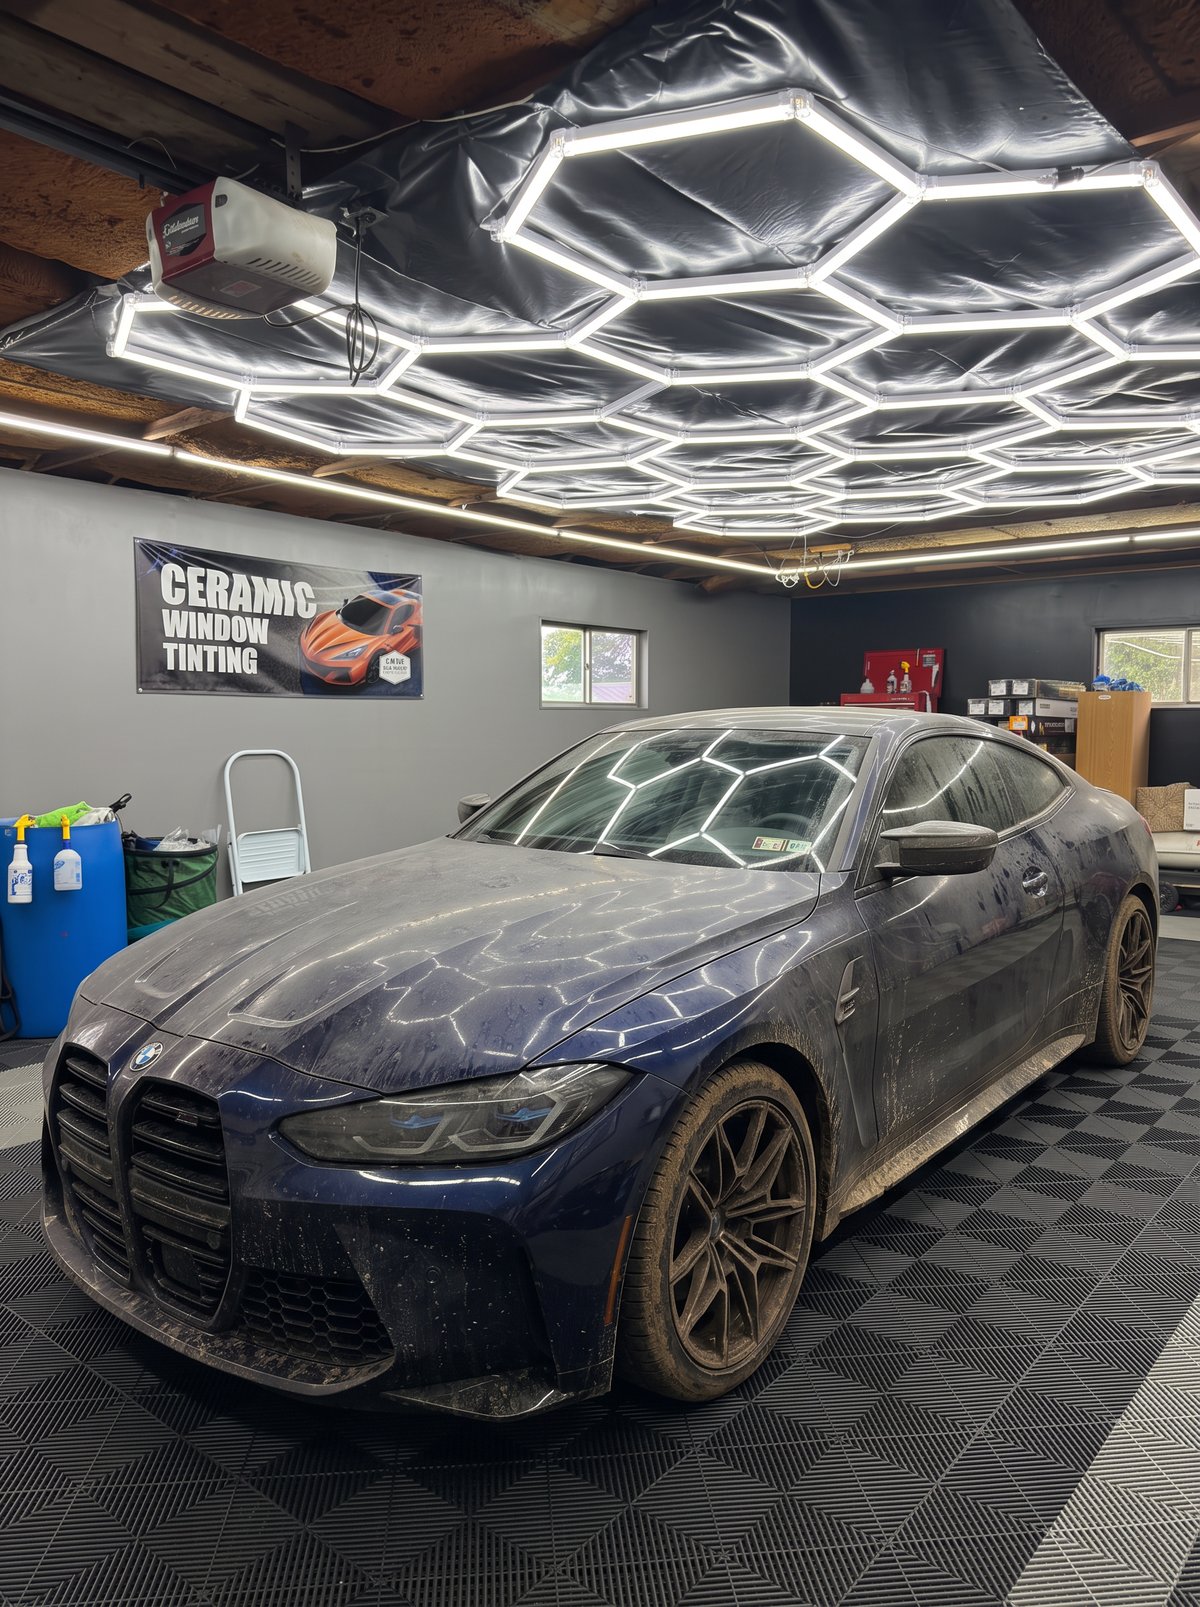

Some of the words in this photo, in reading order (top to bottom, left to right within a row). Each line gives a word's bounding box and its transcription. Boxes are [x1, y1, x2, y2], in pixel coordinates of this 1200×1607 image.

[160, 563, 317, 619] CERAMIC
[161, 609, 269, 645] WINDOW
[162, 643, 258, 674] TINTING
